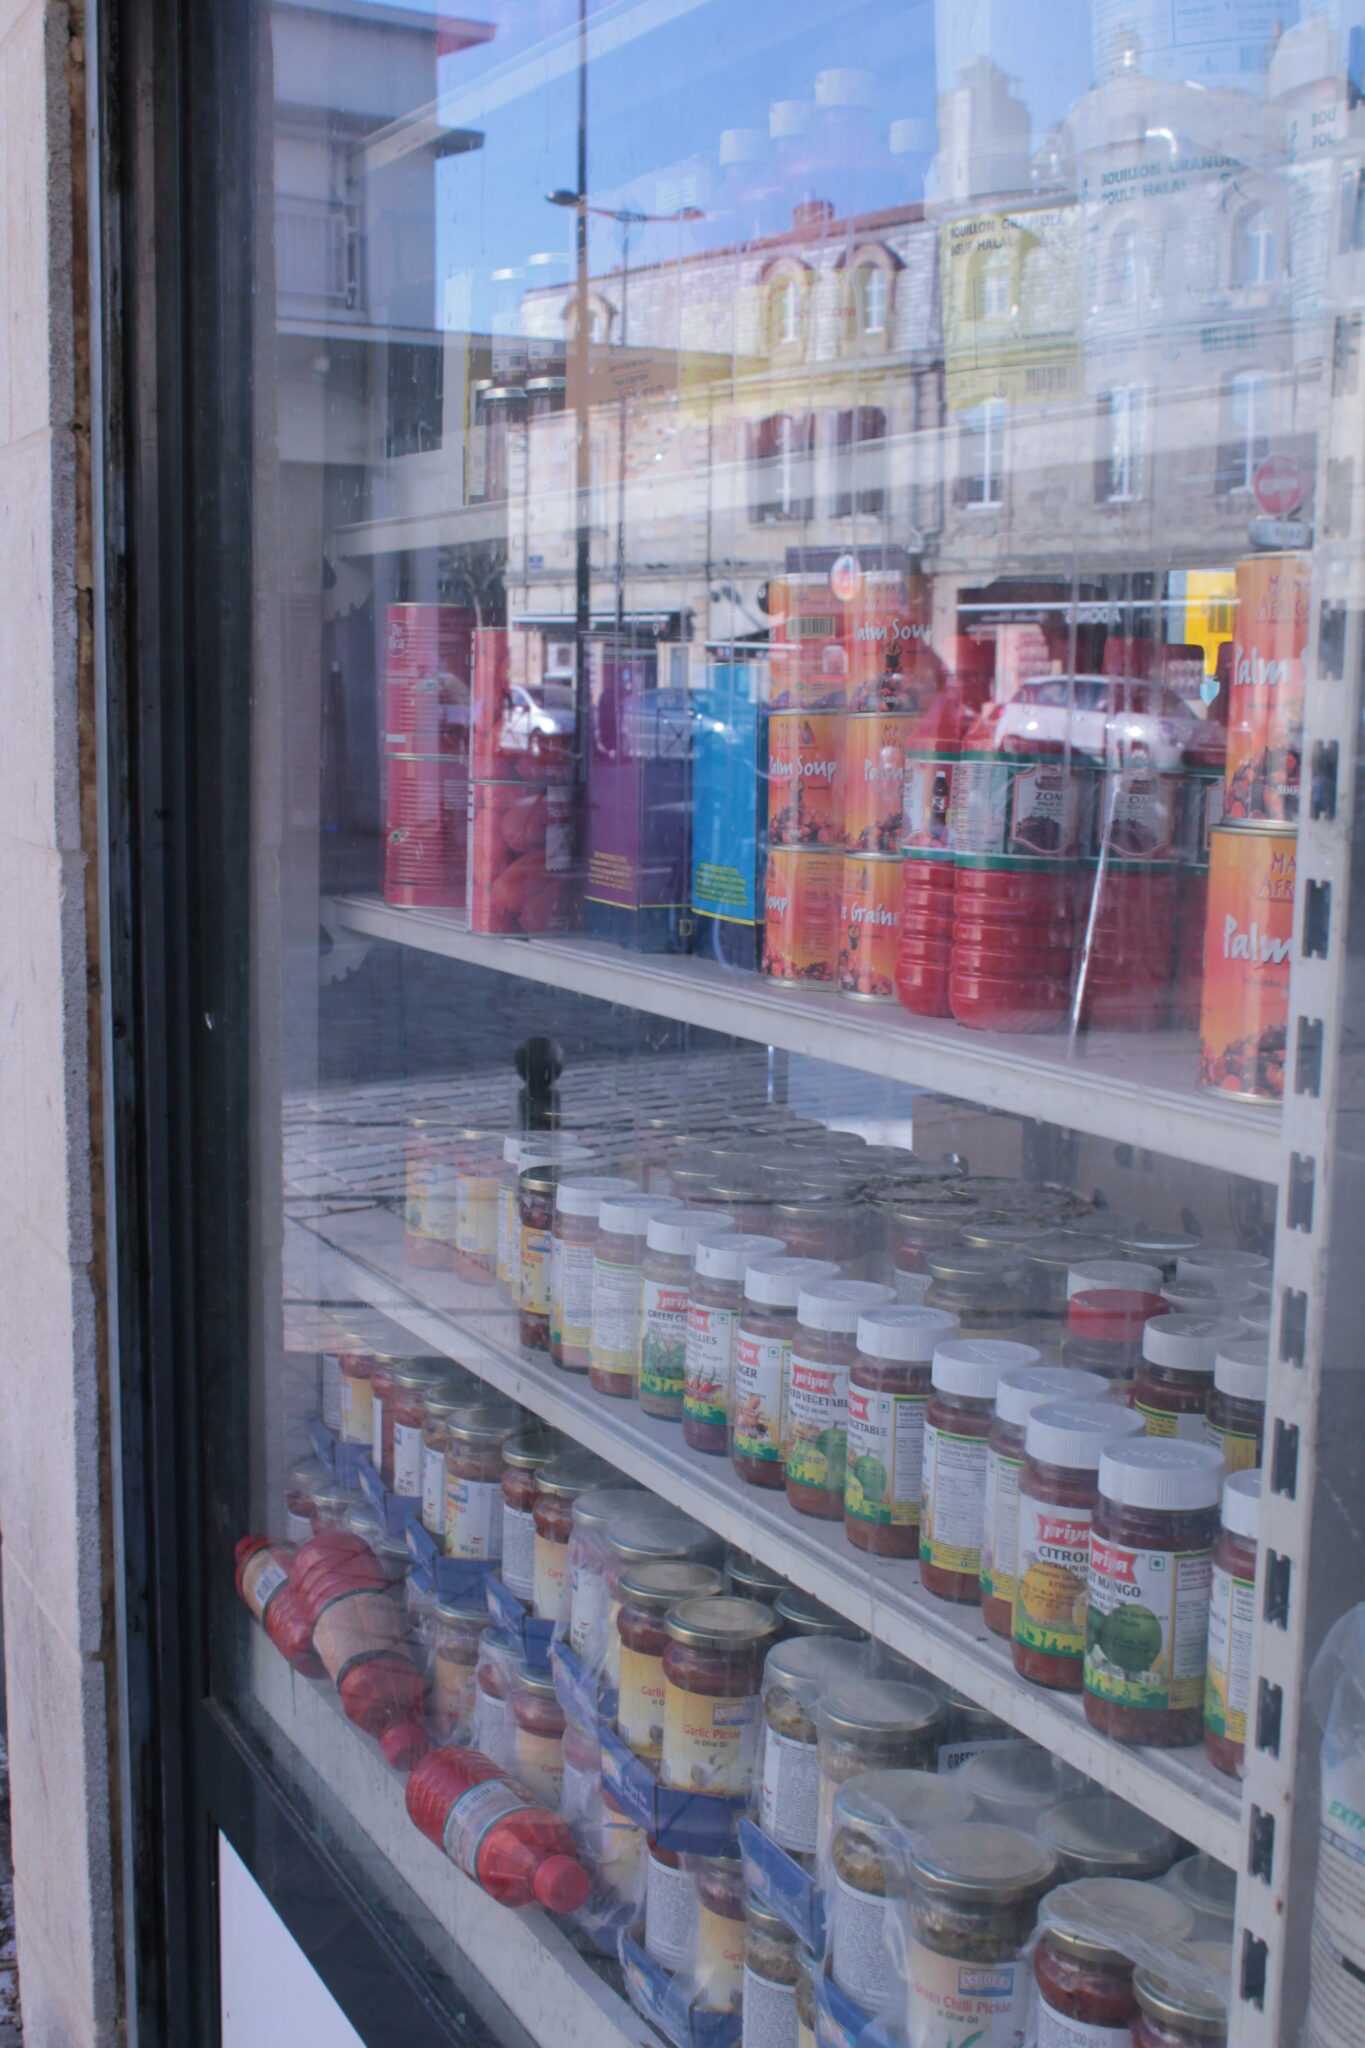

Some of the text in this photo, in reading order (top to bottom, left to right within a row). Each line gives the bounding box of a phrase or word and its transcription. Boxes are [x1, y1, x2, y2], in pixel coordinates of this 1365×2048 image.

[648, 1311, 674, 1323] GREEN
[944, 1996, 972, 2014] Chilli
[977, 2001, 1012, 2014] Pickle
